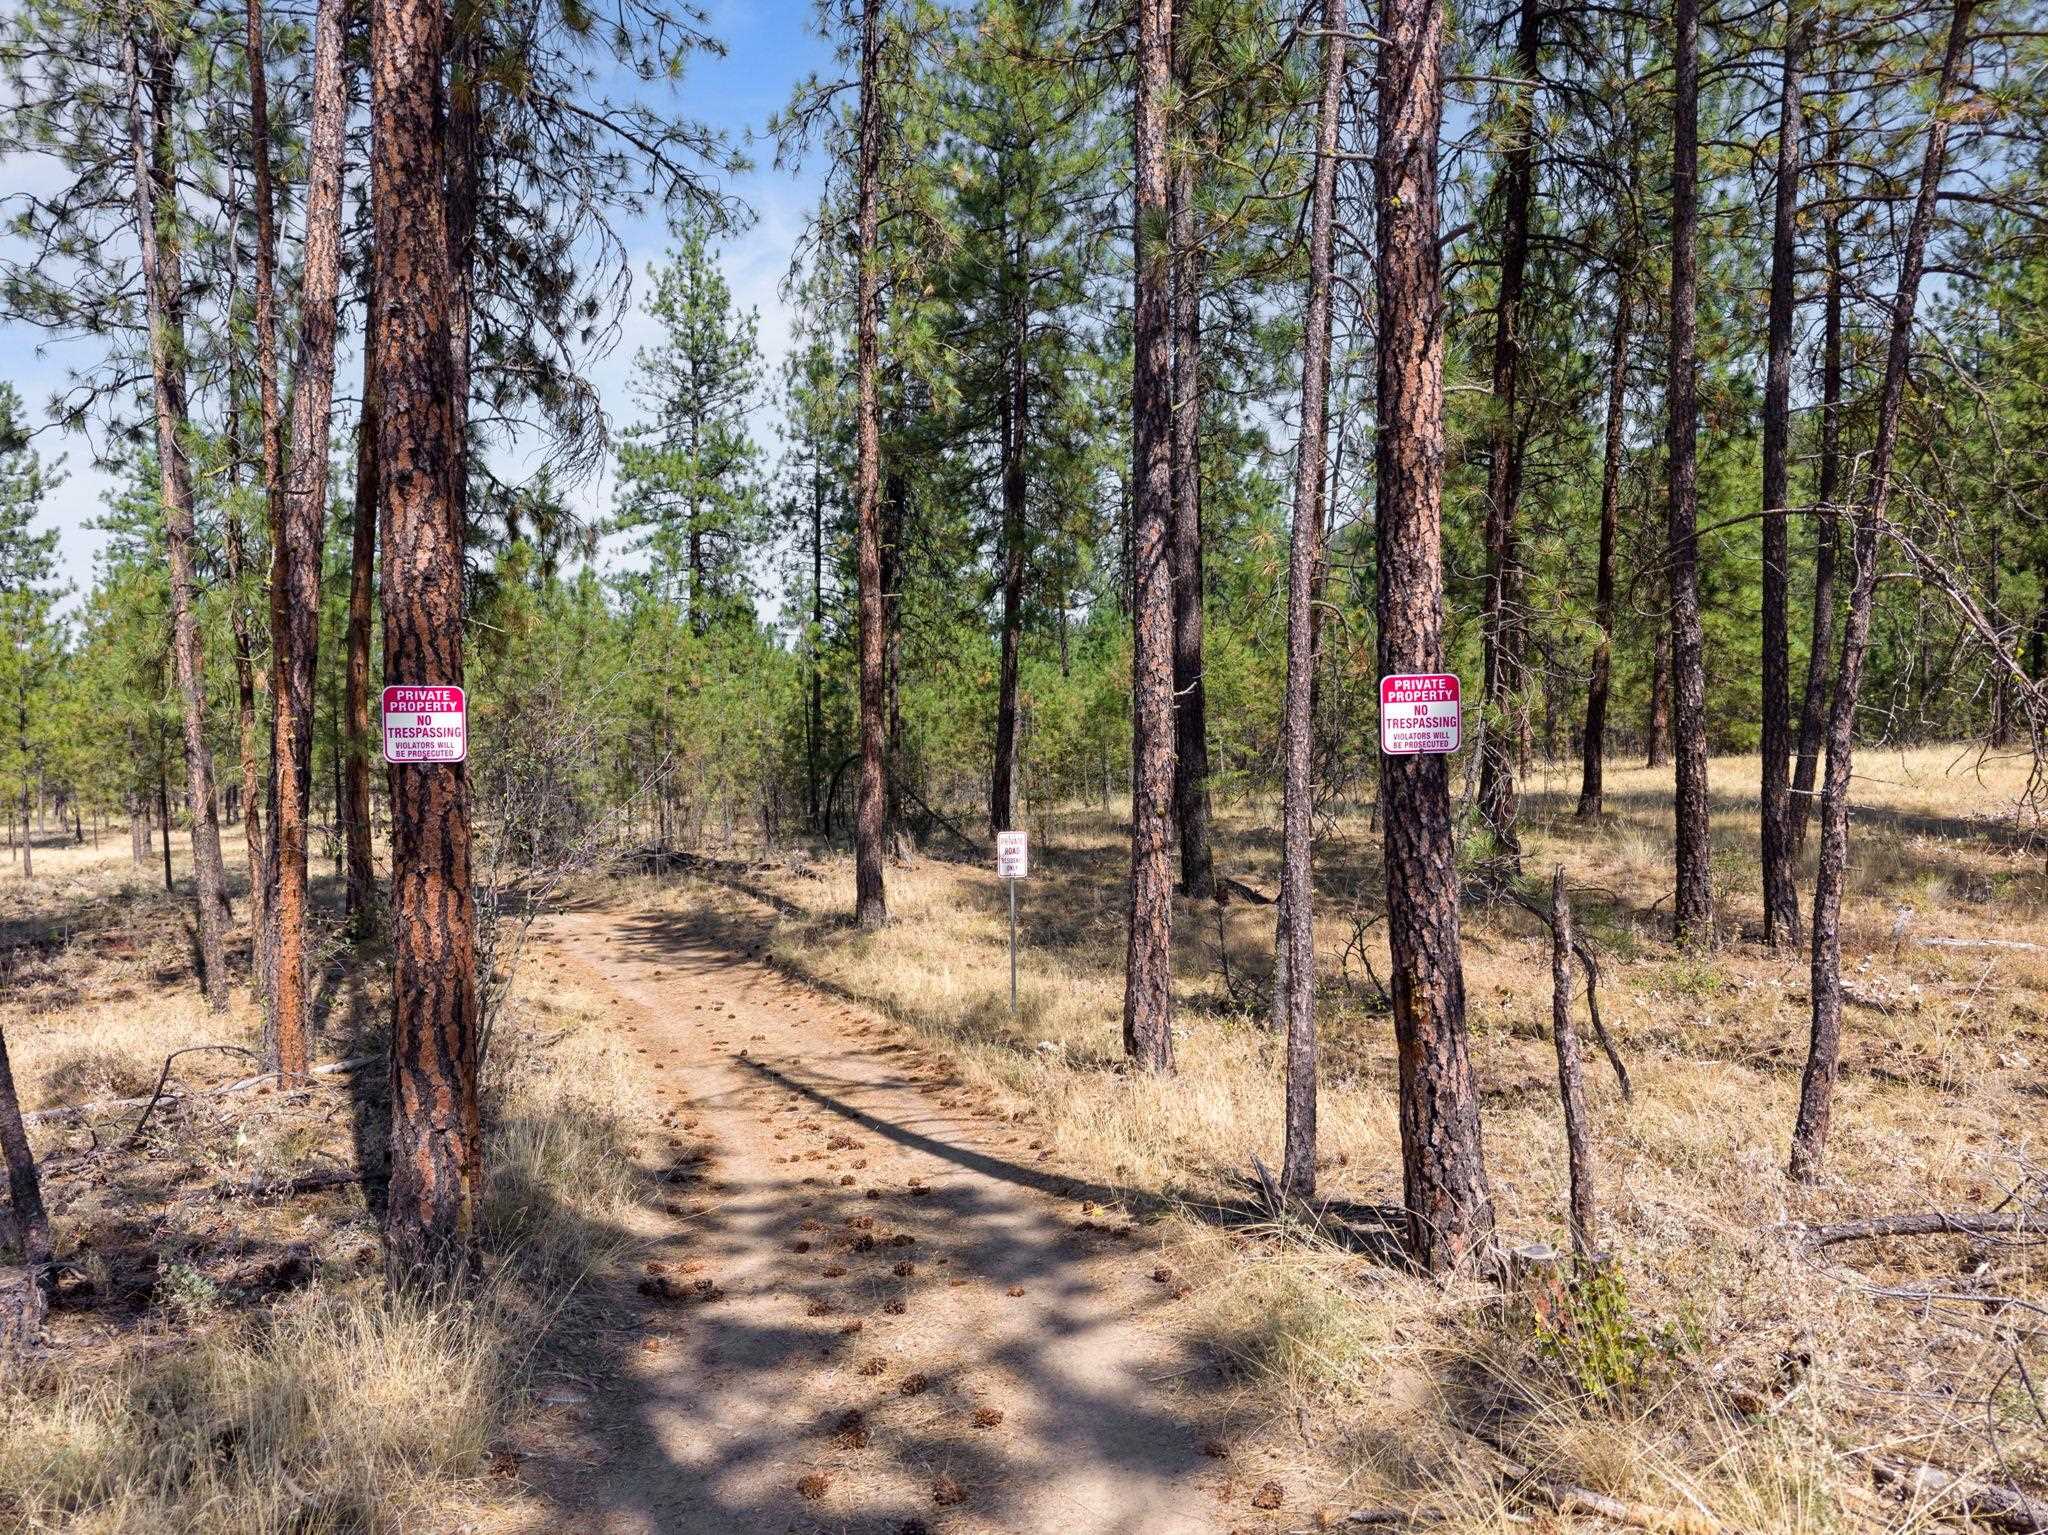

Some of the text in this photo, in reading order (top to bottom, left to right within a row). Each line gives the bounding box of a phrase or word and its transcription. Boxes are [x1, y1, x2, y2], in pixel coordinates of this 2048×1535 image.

[1394, 679, 1446, 690] PRIVATE
[397, 690, 451, 700] PRIVATE
[1388, 690, 1453, 702] PROPERTY
[390, 701, 457, 711] PROPERTY
[1414, 705, 1428, 715] NO
[417, 715, 432, 725] NO
[1386, 717, 1457, 728] TRESPASSING
[388, 728, 462, 738] TRESPASSING
[1393, 732, 1431, 740] VIOLATORS
[1393, 740, 1449, 749] BE PROSECUTED
